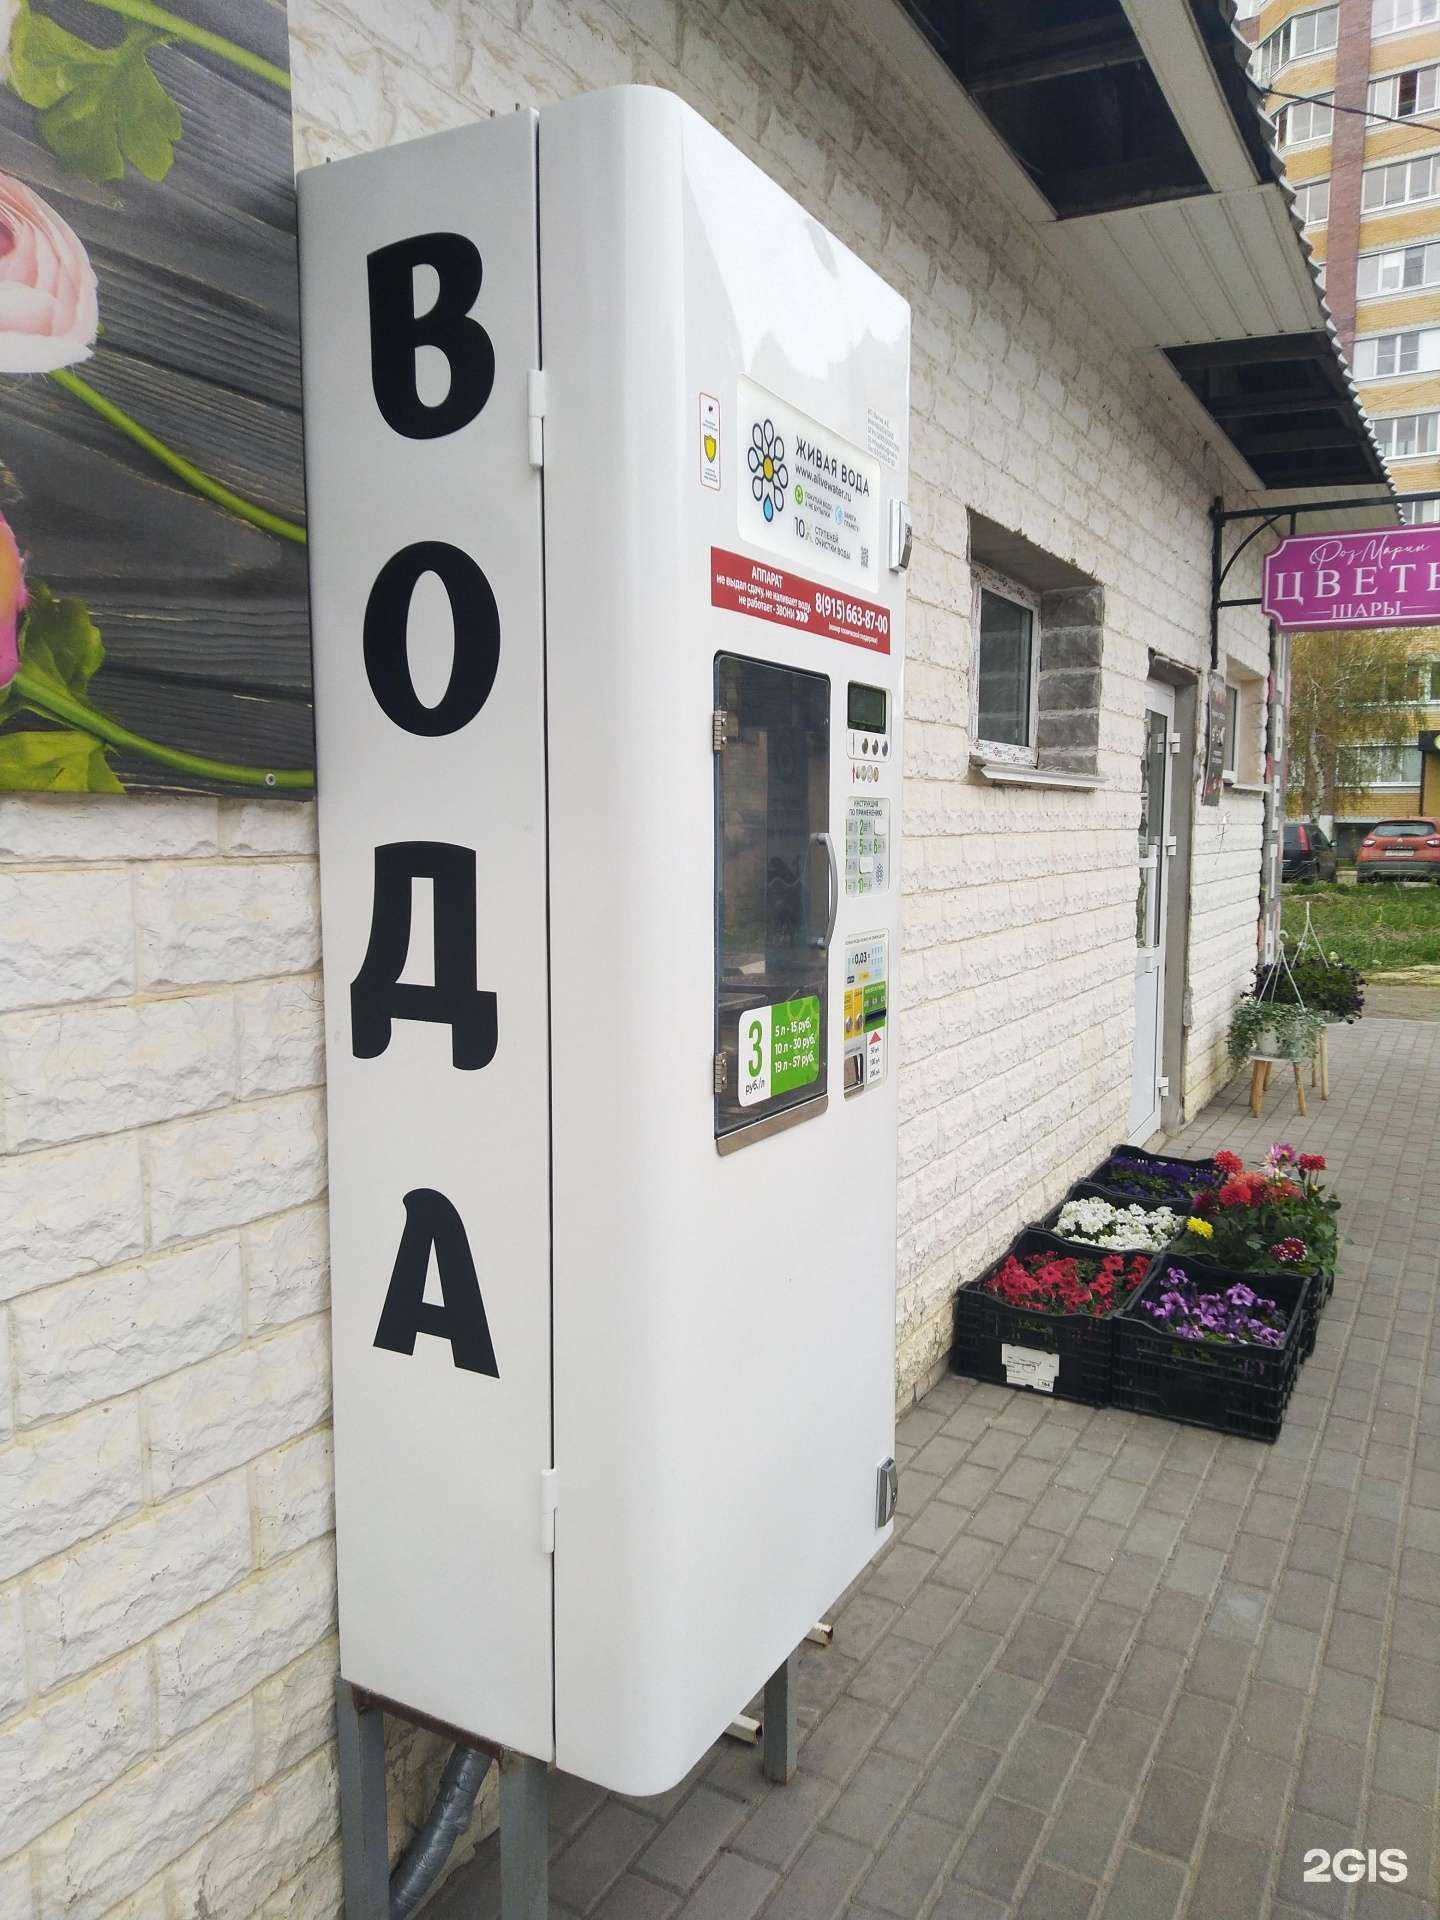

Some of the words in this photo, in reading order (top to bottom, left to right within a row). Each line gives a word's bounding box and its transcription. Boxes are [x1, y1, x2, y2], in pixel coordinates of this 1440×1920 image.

[796, 434, 837, 478] ЖИВАЯ
[841, 463, 870, 496] ВОДА
[795, 463, 852, 502] www.alivewater.ru
[795, 516, 805, 538] 10
[815, 526, 839, 543] СТУПЕНЕЙ
[815, 537, 837, 553] ОЧИСТКИ
[837, 546, 850, 560] ВОДЫ
[752, 566, 783, 588] АППАРАТ
[726, 577, 746, 591] выдал
[766, 588, 773, 599] не
[773, 592, 798, 607] наливает
[738, 595, 746, 606] не
[747, 597, 773, 613] работает
[775, 604, 795, 620] ЗВОНИ
[815, 592, 845, 624] 8(915)
[846, 603, 888, 635] 663-87-00
[1331, 601, 1401, 619] ШАРЫ
[350, 232, 501, 1379] ВОДА
[854, 951, 868, 966] 0,03
[775, 1025, 780, 1037] 5
[781, 1025, 786, 1036] л
[791, 1020, 797, 1033] 15
[748, 1020, 762, 1077] 3
[775, 1043, 782, 1055] 10
[783, 1043, 788, 1053] л
[793, 1037, 801, 1049] 30
[775, 1061, 782, 1073] 19
[783, 1061, 788, 1071] л
[792, 1055, 801, 1068] 57
